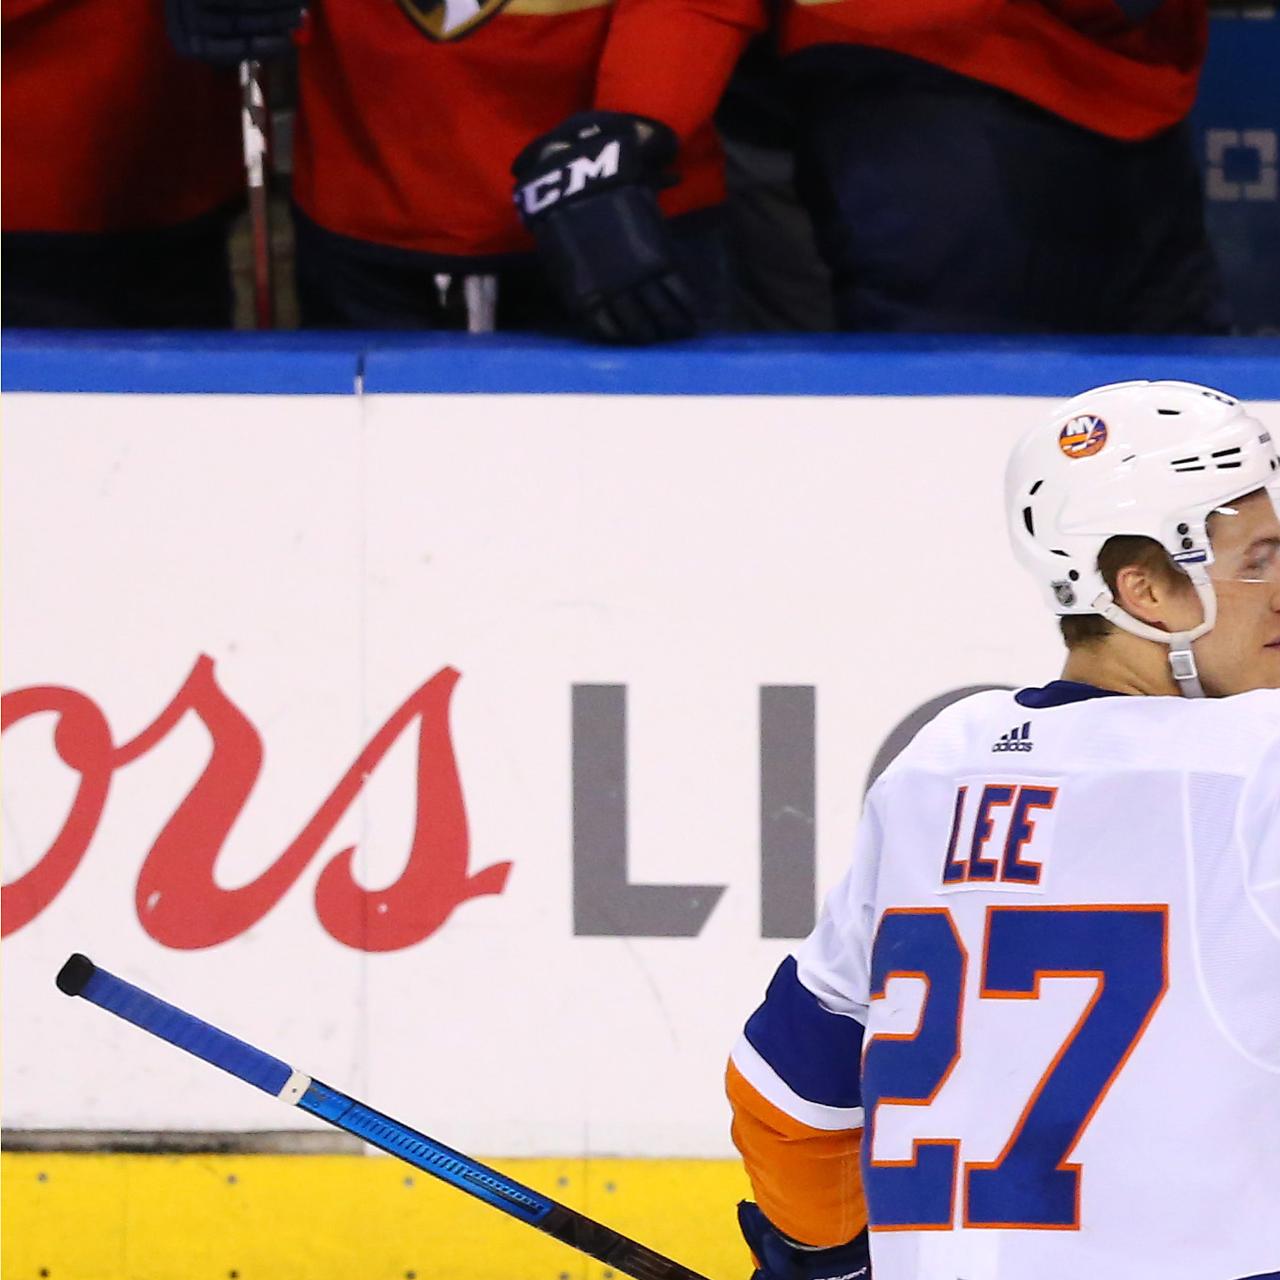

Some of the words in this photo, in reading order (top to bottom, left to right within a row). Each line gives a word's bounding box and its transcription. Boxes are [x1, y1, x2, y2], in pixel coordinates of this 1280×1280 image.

[512, 138, 622, 216] CM
[991, 741, 1034, 753] adidas
[943, 783, 1059, 886] LEE
[860, 904, 1169, 1231] 27
